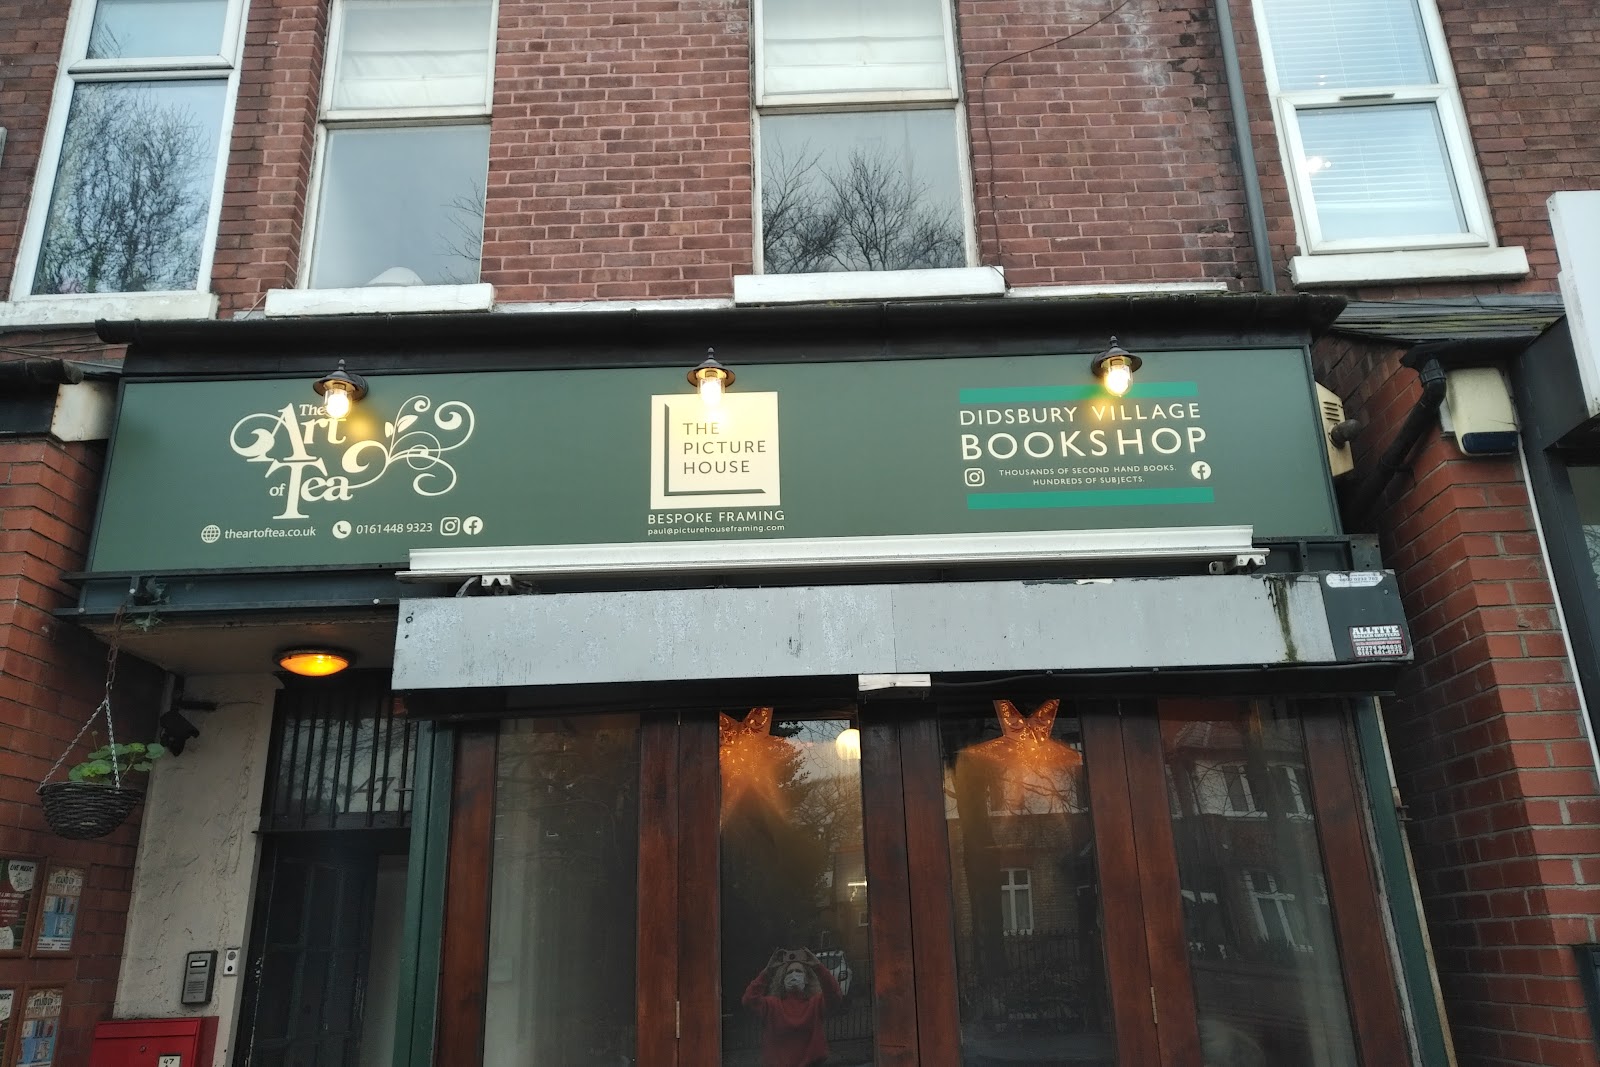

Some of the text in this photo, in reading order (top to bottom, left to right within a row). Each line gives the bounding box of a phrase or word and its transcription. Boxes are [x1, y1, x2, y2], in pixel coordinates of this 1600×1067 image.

[299, 404, 326, 416] The
[959, 403, 1201, 426] DIDSBURY VILLAGE
[230, 402, 346, 462] Art
[682, 422, 720, 435] THE
[684, 440, 767, 454] PICTURE
[961, 427, 1207, 460] BOOKSHOP
[684, 460, 750, 474] HOUSE
[999, 464, 1177, 477] THOUSANDS OF SECOND HAND BOOKS.
[1033, 477, 1083, 486] HUNDREDS
[1100, 475, 1145, 485] SUBJECTS.
[265, 458, 353, 520] Tea
[268, 483, 287, 497] of
[648, 510, 785, 524] BESPOKE FRAMING
[224, 525, 317, 540] theartoftea.co.uk
[406, 522, 433, 533] 9323
[648, 524, 785, 536] paul@picturehouseframing.com
[1352, 625, 1399, 634] ALLTITE
